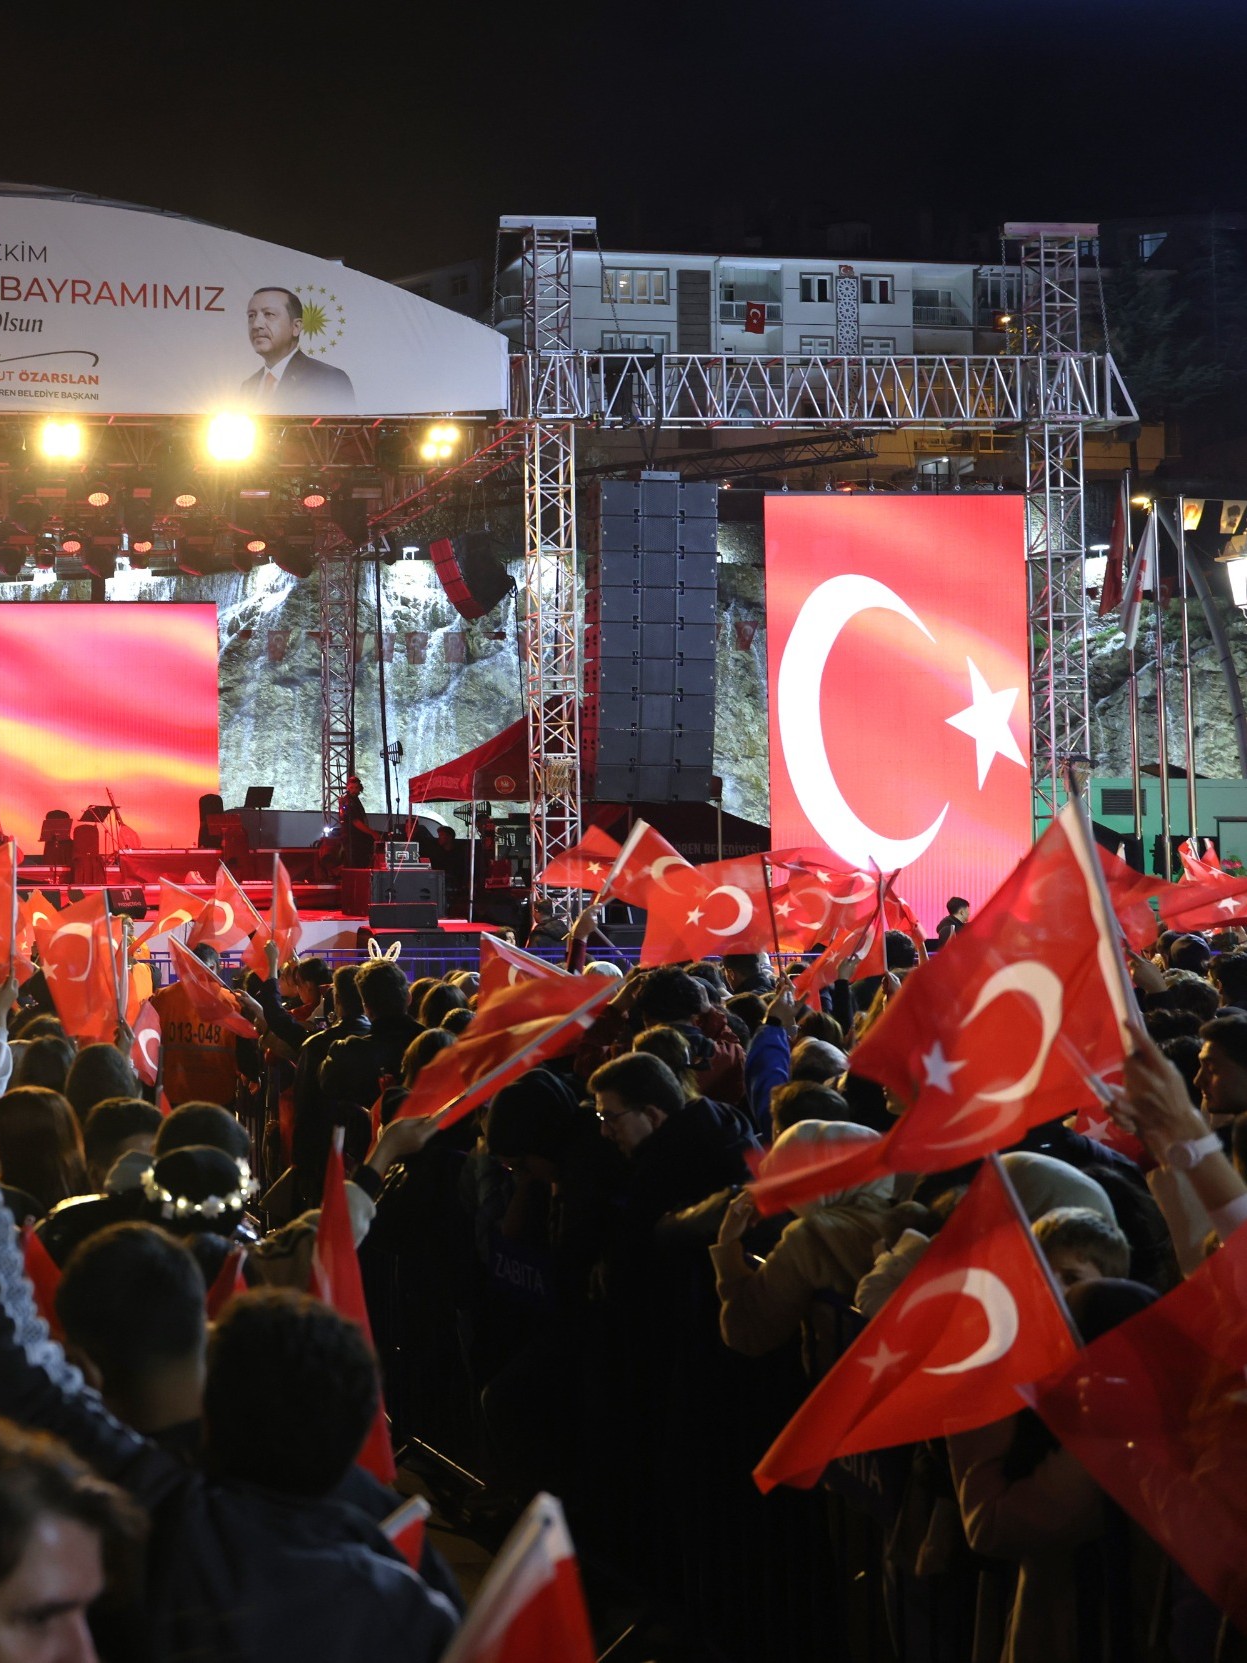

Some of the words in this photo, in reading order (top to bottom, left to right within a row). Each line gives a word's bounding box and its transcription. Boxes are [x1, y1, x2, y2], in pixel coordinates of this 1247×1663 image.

[0, 275, 225, 312] BAYRAMIMIZ
[18, 369, 99, 385] ÖZARSLAN
[17, 388, 60, 399] BELEDİYE
[60, 391, 99, 401] BAŞKANI
[703, 841, 760, 856] BEEDİYESİ
[495, 1252, 545, 1296] ZABITA
